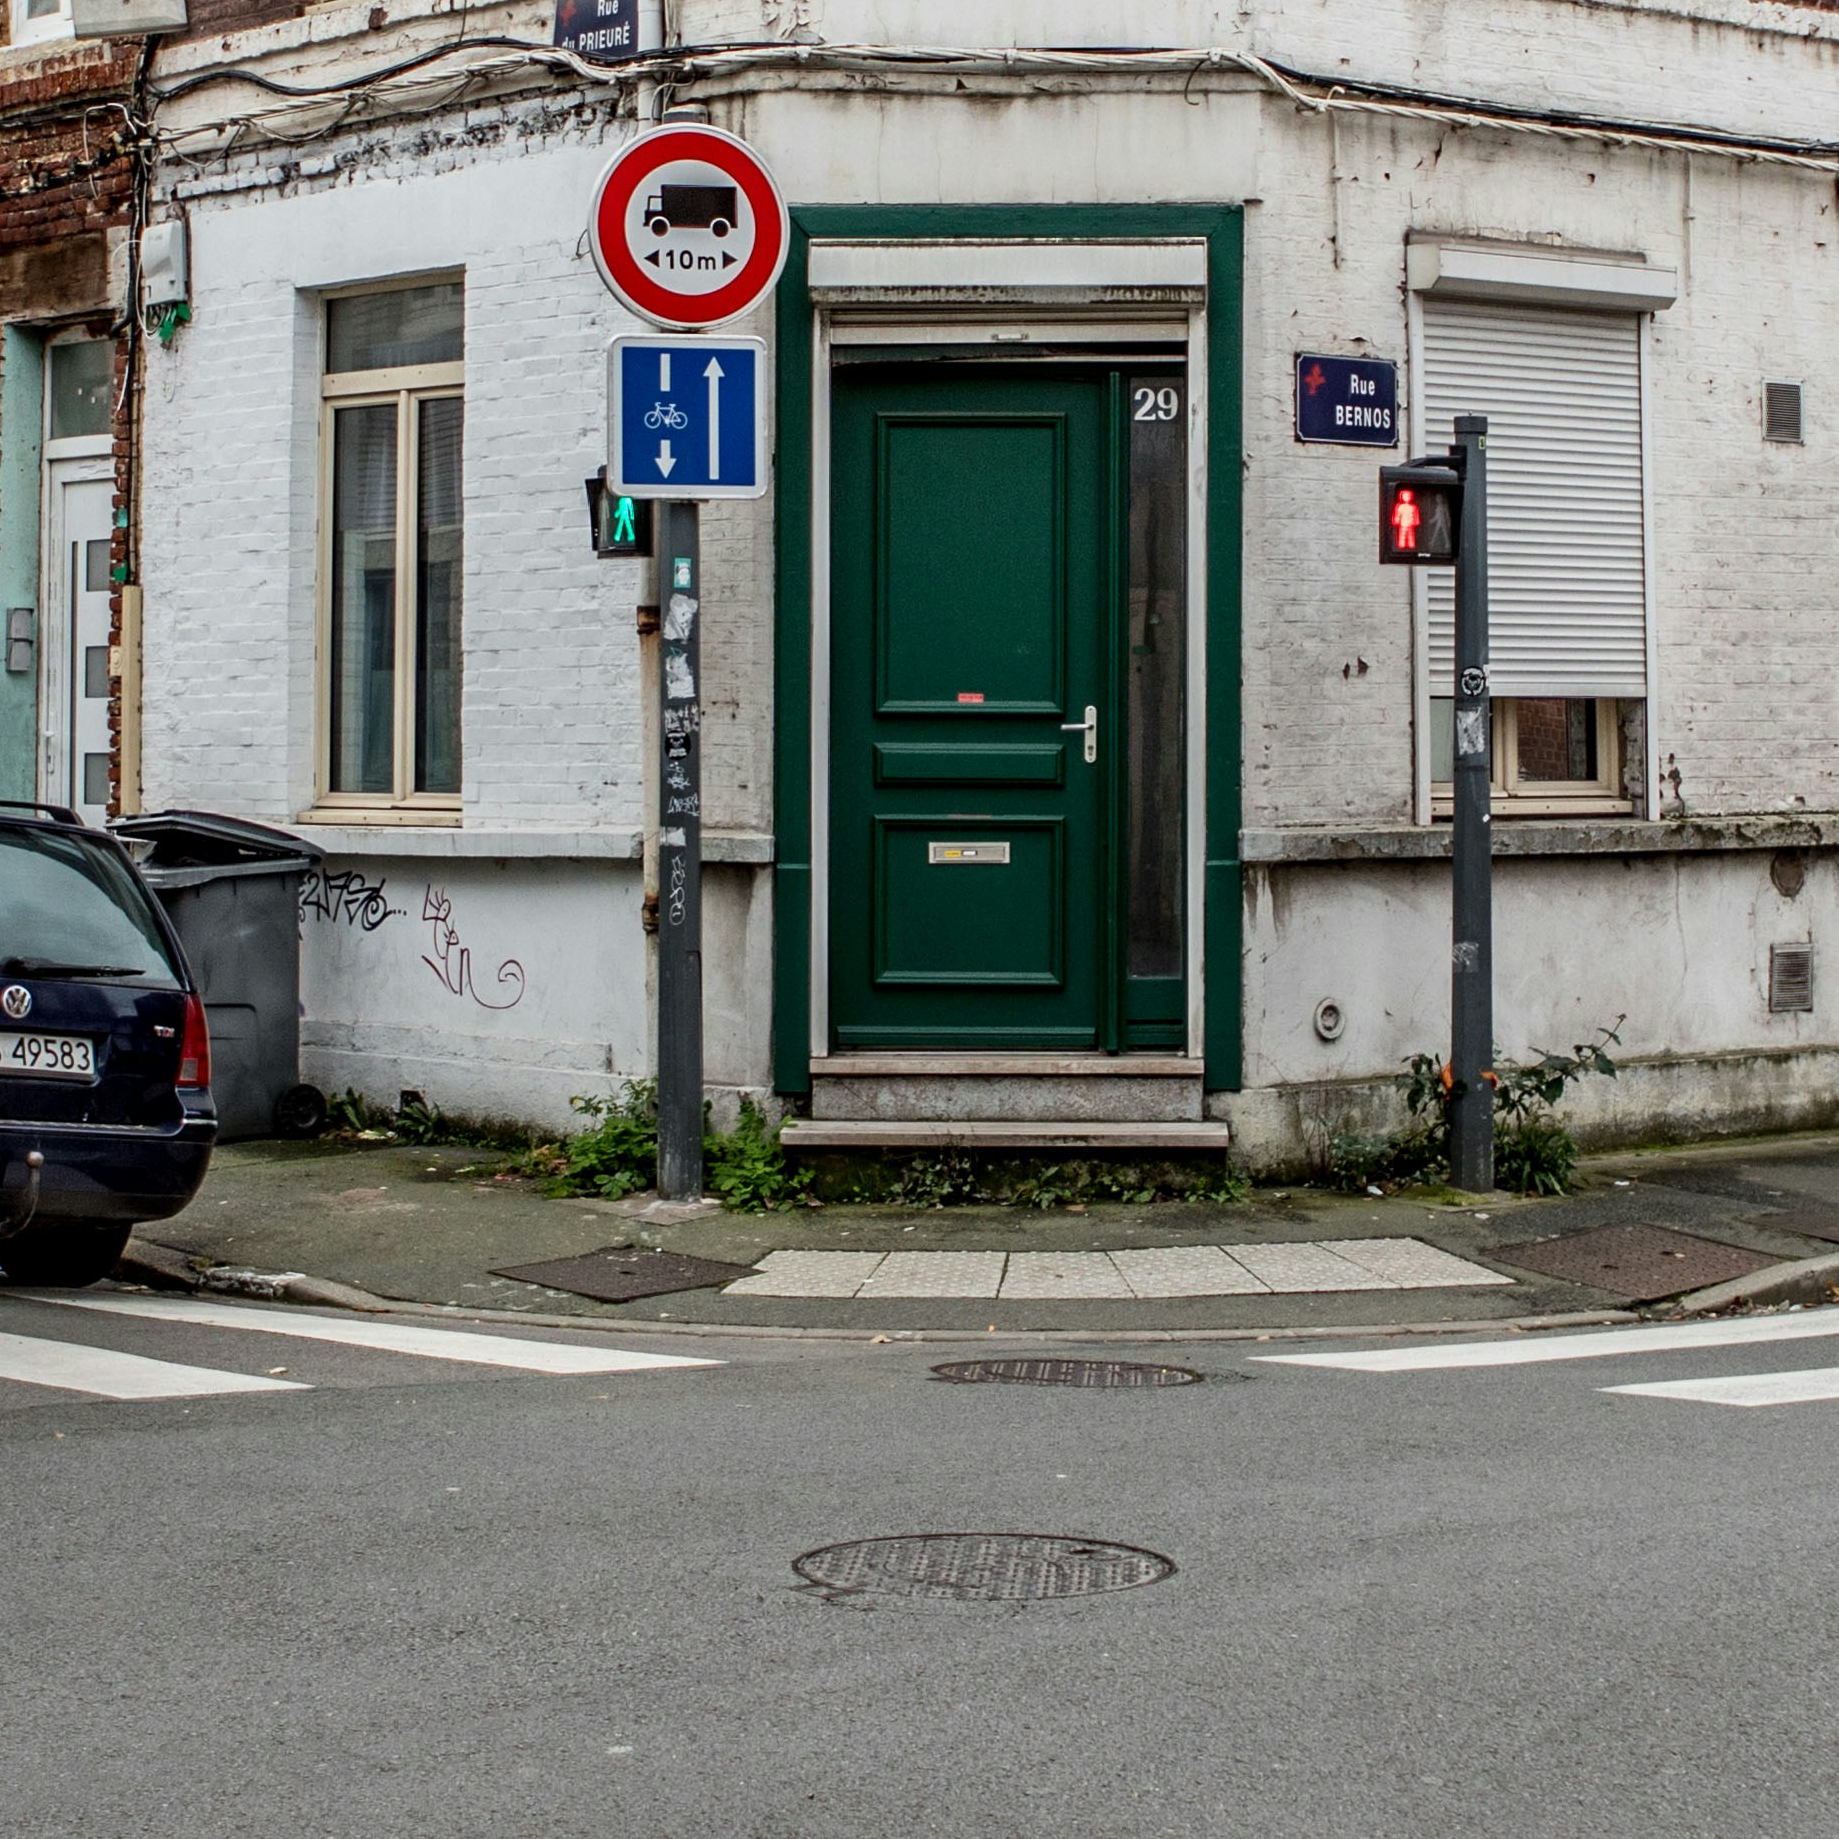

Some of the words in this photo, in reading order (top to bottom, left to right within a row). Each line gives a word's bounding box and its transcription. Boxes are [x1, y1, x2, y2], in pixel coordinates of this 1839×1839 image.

[579, 21, 630, 51] PRIEURÉ
[1350, 373, 1376, 396] Rue
[1134, 387, 1179, 421] 29
[1335, 404, 1391, 429] BERNOS
[12, 1036, 91, 1071] 49583
